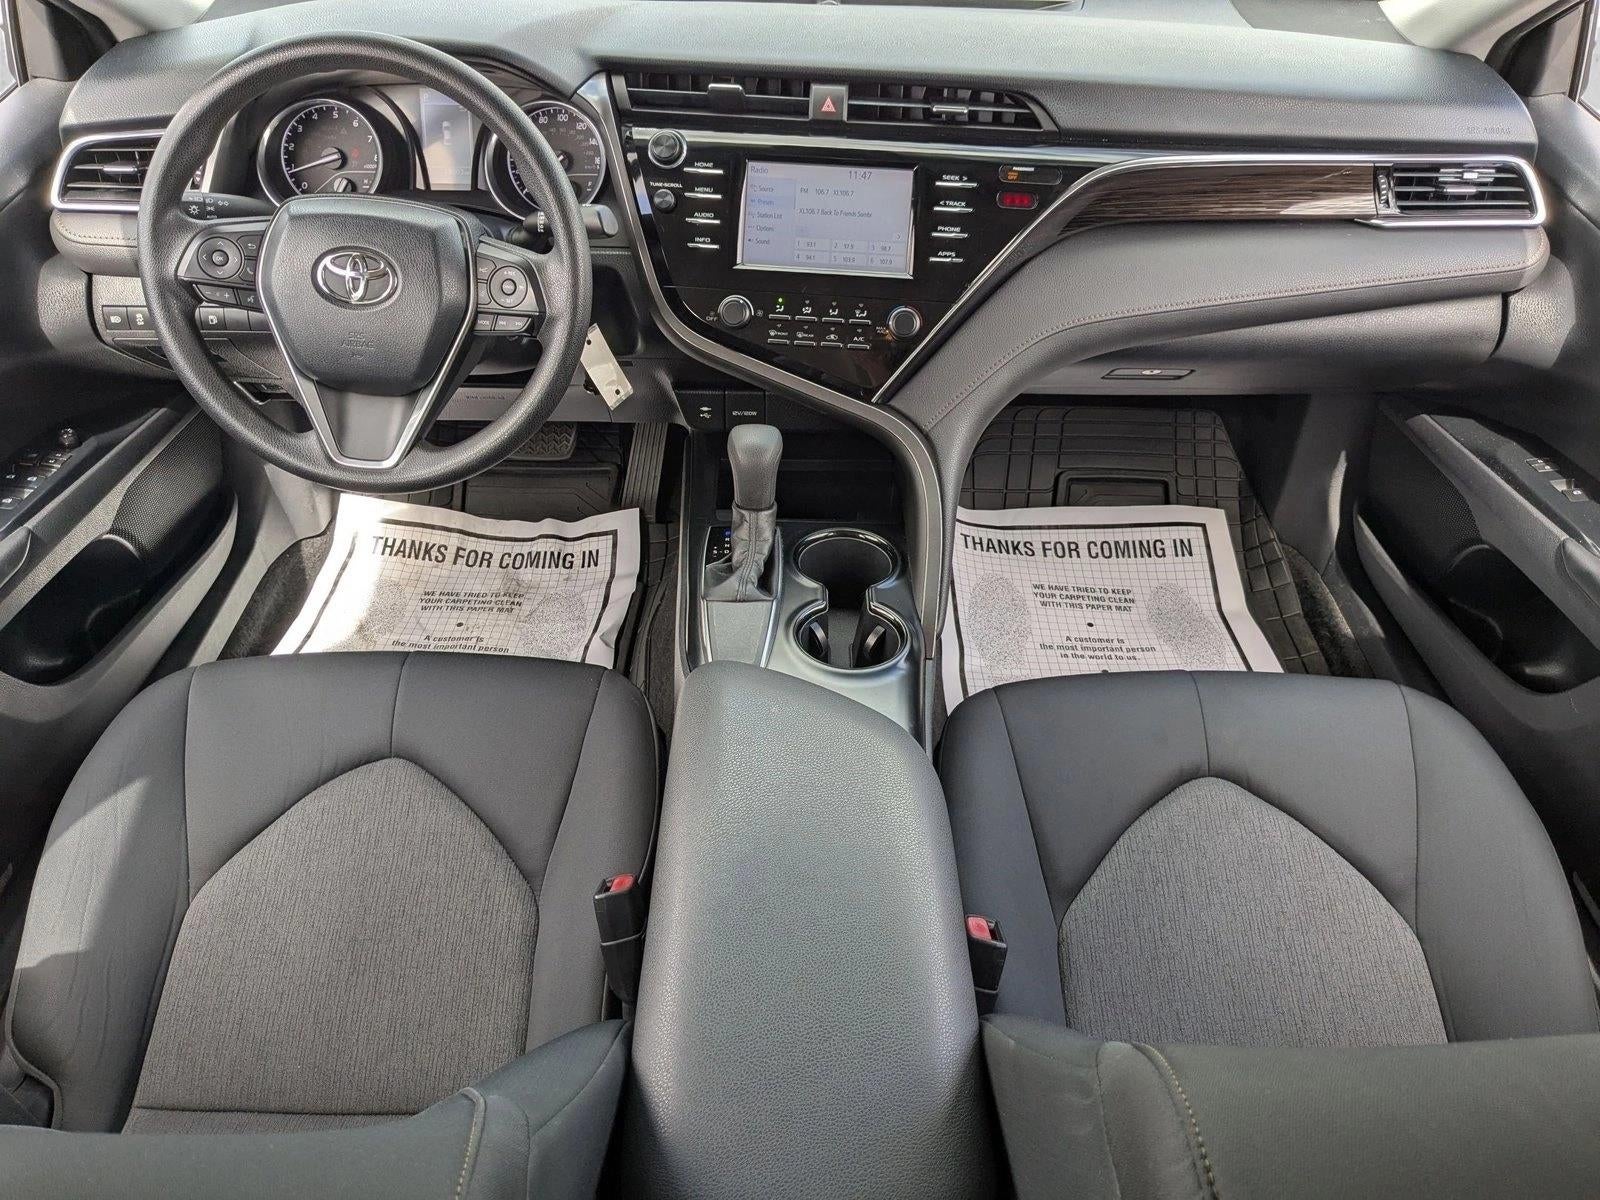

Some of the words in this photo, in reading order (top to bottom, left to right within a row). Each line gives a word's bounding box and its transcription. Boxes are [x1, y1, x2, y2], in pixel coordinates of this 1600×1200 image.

[333, 111, 339, 119] 5
[557, 114, 569, 122] 100
[353, 120, 359, 128] 6
[576, 123, 588, 131] 120
[298, 125, 303, 133] 3
[288, 143, 295, 151] 2
[750, 165, 769, 174] Radio
[848, 169, 872, 180] 11:47
[301, 181, 308, 189] 0
[815, 188, 830, 196] 106.7
[757, 211, 774, 219] Station
[937, 225, 961, 233] PHONE
[755, 237, 770, 245] Sound
[960, 533, 1036, 557] THANKS
[1041, 541, 1080, 559] FOR
[1086, 539, 1166, 559] COMING
[1172, 538, 1193, 558] IN
[372, 535, 448, 563] THANKS
[453, 546, 494, 568] FOR
[499, 551, 575, 570] COMING
[581, 549, 600, 568] IN
[1032, 583, 1046, 591] WE
[1047, 584, 1069, 592] HAVE
[1071, 585, 1096, 594] TRIED
[1098, 587, 1109, 595] TO
[1111, 588, 1132, 596] KEEP
[1033, 591, 1057, 600] YOUR
[1059, 593, 1106, 603] CARPETING
[1107, 596, 1135, 605] CLEAN
[1040, 600, 1062, 608] WITH
[1064, 602, 1084, 610] THIS
[1085, 603, 1113, 612] PAPER
[1114, 605, 1133, 613] MAT
[433, 643, 477, 651] important
[477, 645, 509, 653] person
[1039, 643, 1055, 651] the
[1080, 645, 1124, 654] important
[1125, 646, 1157, 654] person
[1071, 652, 1086, 660] the
[1087, 653, 1113, 661] world
